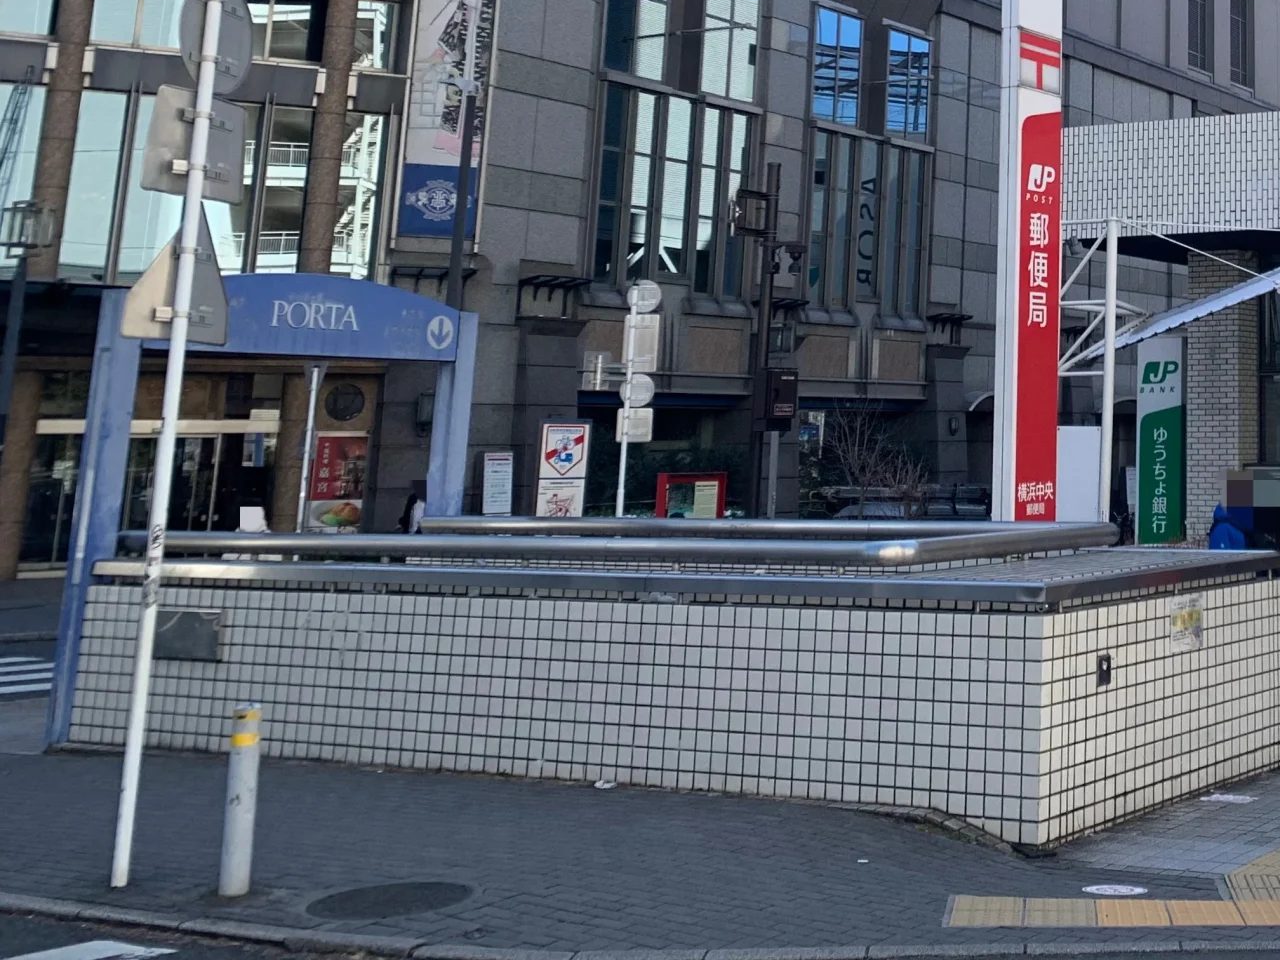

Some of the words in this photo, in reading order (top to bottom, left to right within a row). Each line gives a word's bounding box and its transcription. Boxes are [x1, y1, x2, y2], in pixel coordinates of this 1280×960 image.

[1026, 192, 1054, 205] POST
[1027, 212, 1050, 328] 郵便局
[270, 300, 360, 332] PORTA
[1141, 360, 1179, 384] JP
[1140, 386, 1176, 394] BANK
[1151, 426, 1168, 534] ゆうちょ銀行
[1017, 481, 1054, 503] 横浜中央
[1025, 502, 1045, 516] 郵便局
